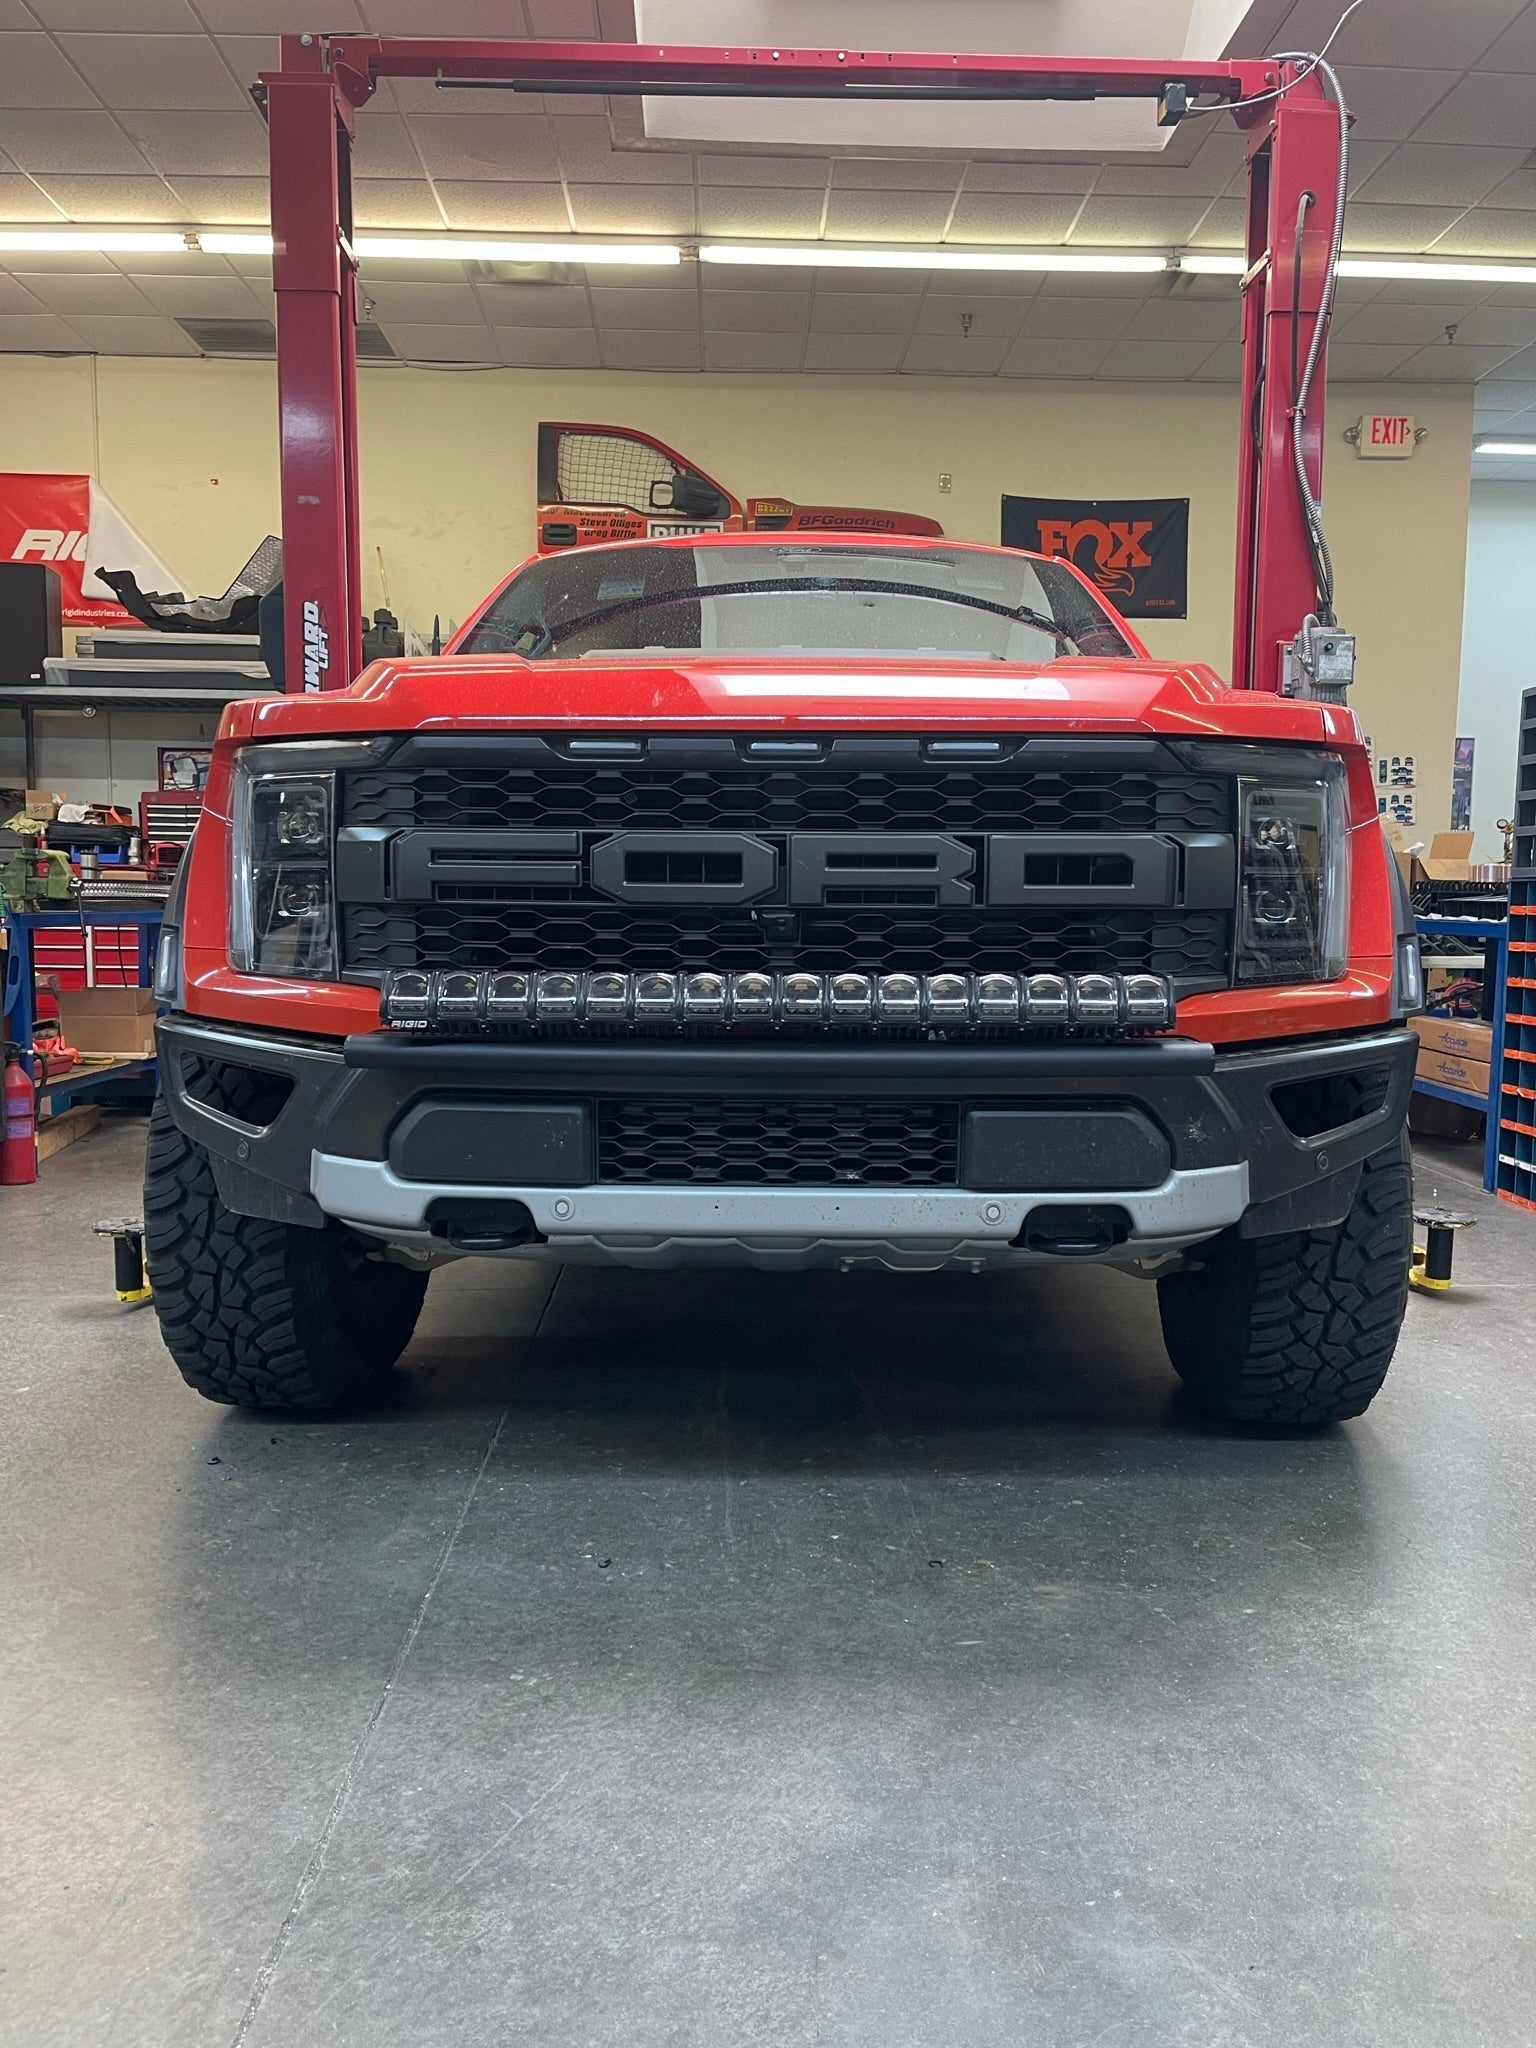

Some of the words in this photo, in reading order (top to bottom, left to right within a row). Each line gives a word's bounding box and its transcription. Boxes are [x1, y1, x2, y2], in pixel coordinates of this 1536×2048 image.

[1371, 417, 1408, 444] EXIT
[580, 517, 607, 527] Steve
[798, 515, 895, 529] BFGoodrich
[1037, 519, 1153, 568] FOX
[62, 607, 134, 618] rigidindustries.co
[318, 627, 329, 669] LIFT
[389, 829, 1180, 909] FORD
[391, 1020, 428, 1029] RIGID
